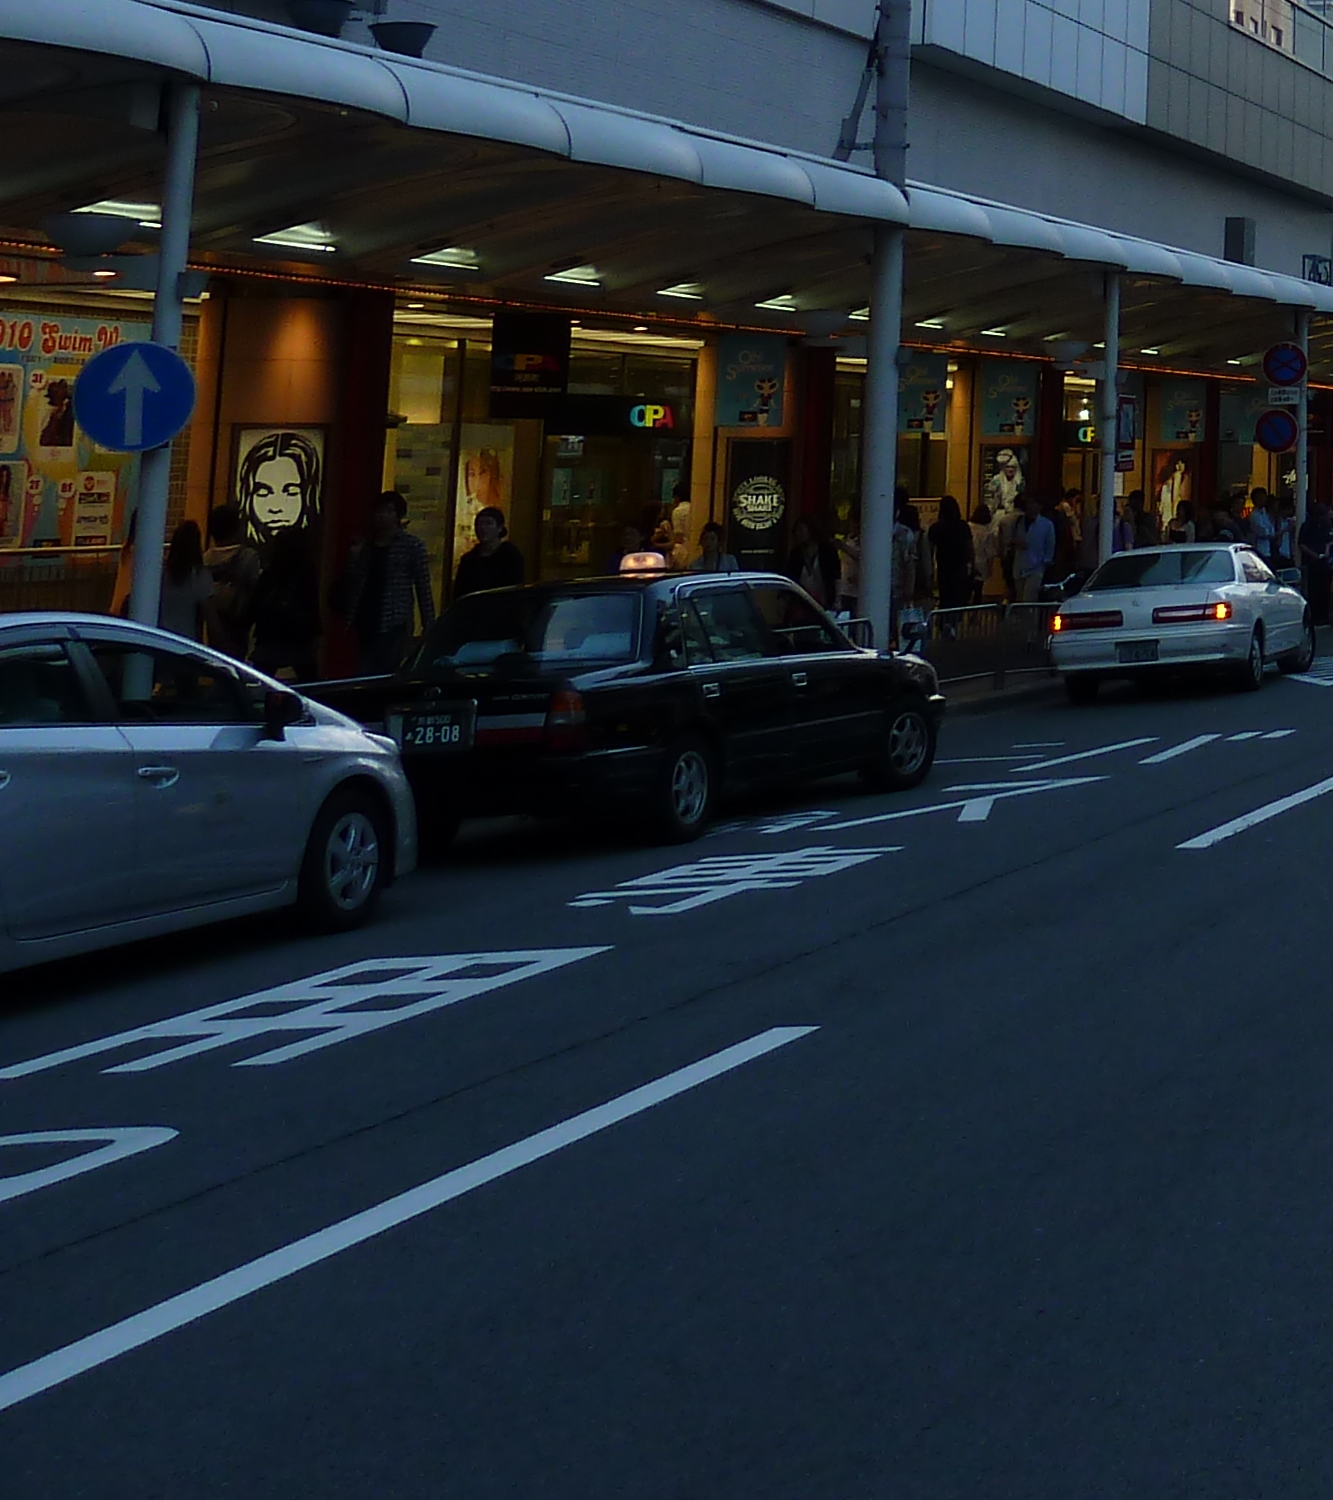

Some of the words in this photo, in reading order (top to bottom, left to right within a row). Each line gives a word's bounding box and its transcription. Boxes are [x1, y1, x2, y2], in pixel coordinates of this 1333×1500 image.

[40, 321, 94, 354] Swim
[97, 325, 128, 350] W
[628, 402, 675, 430] OPA
[739, 493, 780, 507] SHAKE
[414, 725, 460, 745] 28-08
